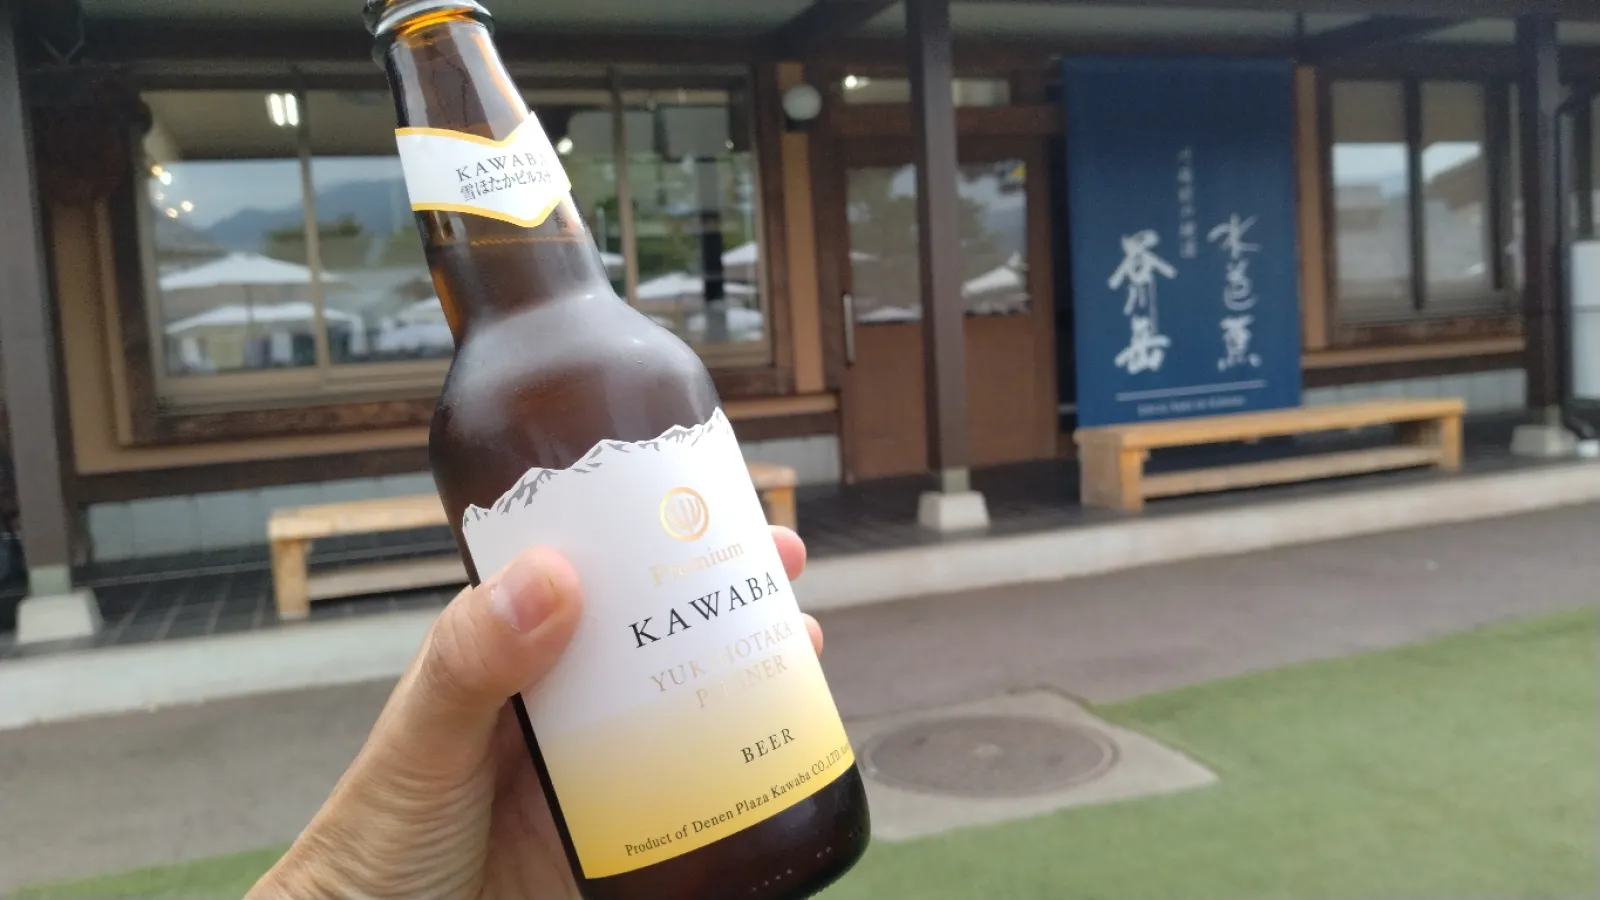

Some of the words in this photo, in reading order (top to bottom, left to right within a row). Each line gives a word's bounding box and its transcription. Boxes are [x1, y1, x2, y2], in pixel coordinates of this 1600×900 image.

[1108, 229, 1177, 375] 谷川岳
[1207, 212, 1263, 372] 水芭蕉
[650, 541, 745, 587] Premium
[628, 571, 779, 648] KAWABA
[650, 655, 714, 692] YUK
[695, 654, 788, 708] PLSNER
[740, 728, 795, 764] BEER
[625, 832, 672, 856] Product
[675, 825, 689, 840] of
[692, 808, 735, 833] Denen
[735, 794, 770, 816] Plaza
[770, 771, 812, 799] Kawaba
